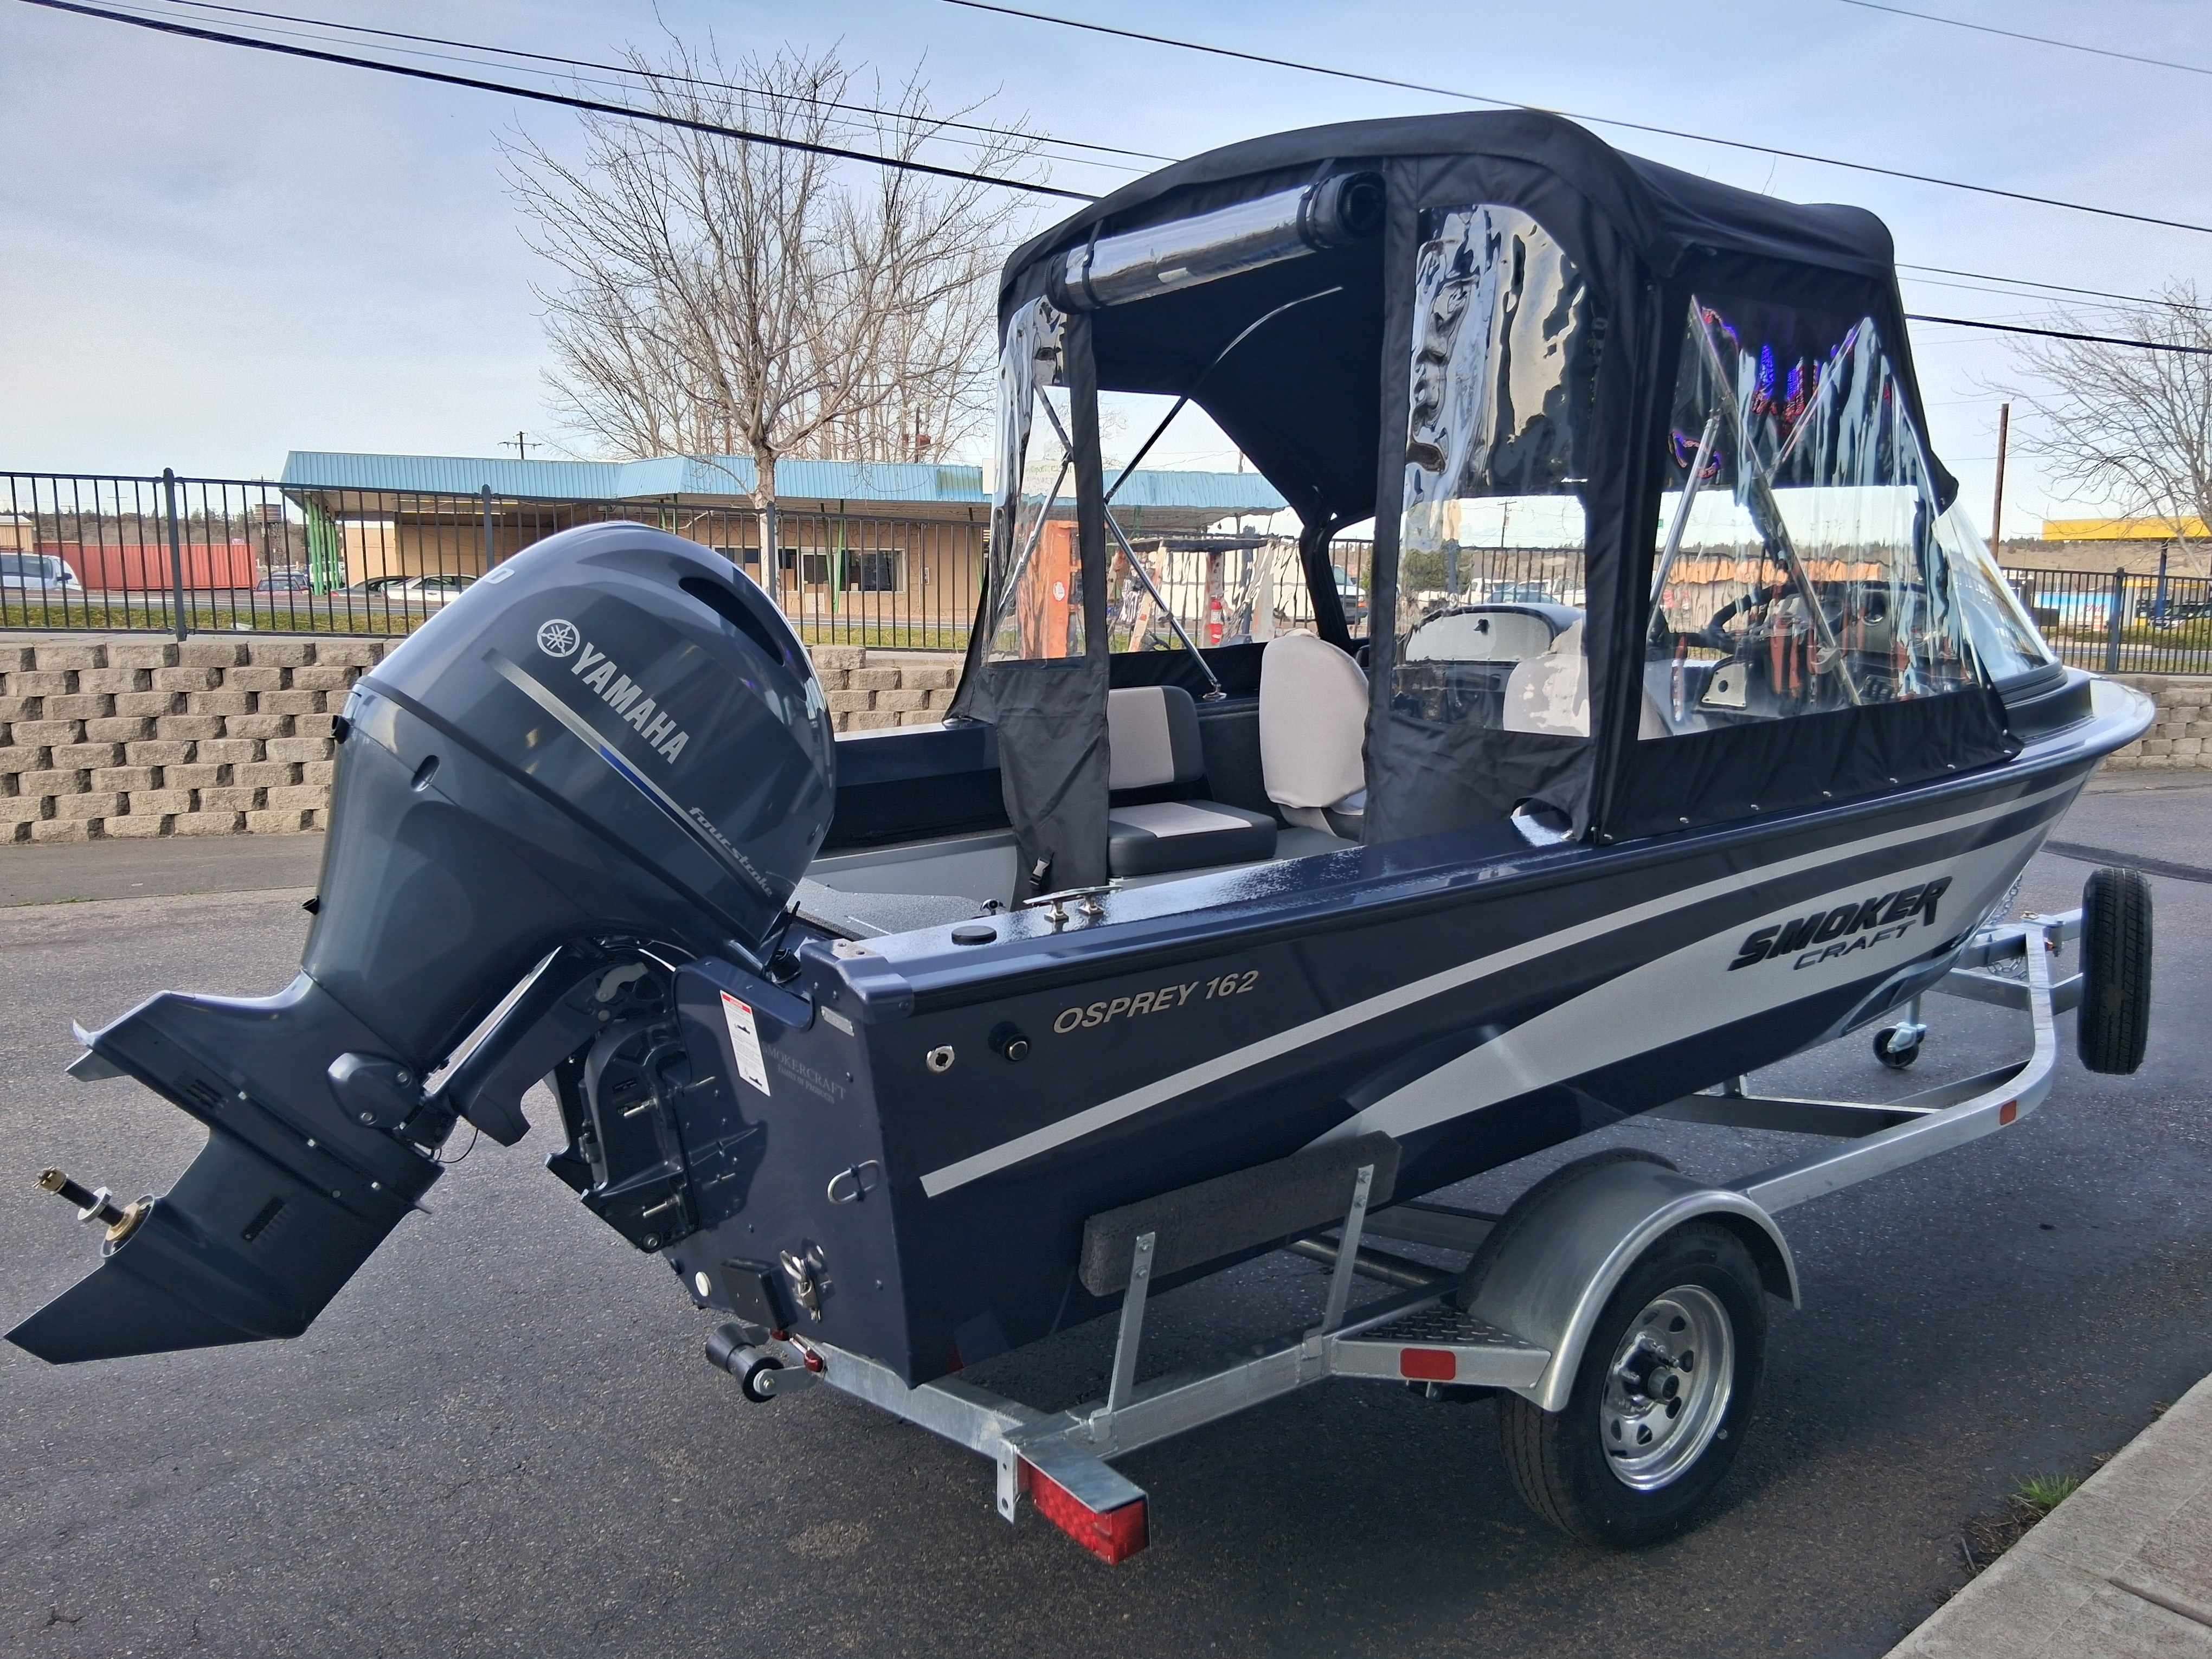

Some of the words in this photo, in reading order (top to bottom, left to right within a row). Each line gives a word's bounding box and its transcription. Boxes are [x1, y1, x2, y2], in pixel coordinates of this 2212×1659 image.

[571, 641, 690, 765] YAMAHA
[1727, 876, 1953, 972] SMOKER
[1793, 919, 1917, 970] CRAFT
[1053, 980, 1199, 1034] OSPREY
[1205, 970, 1259, 1000] 162
